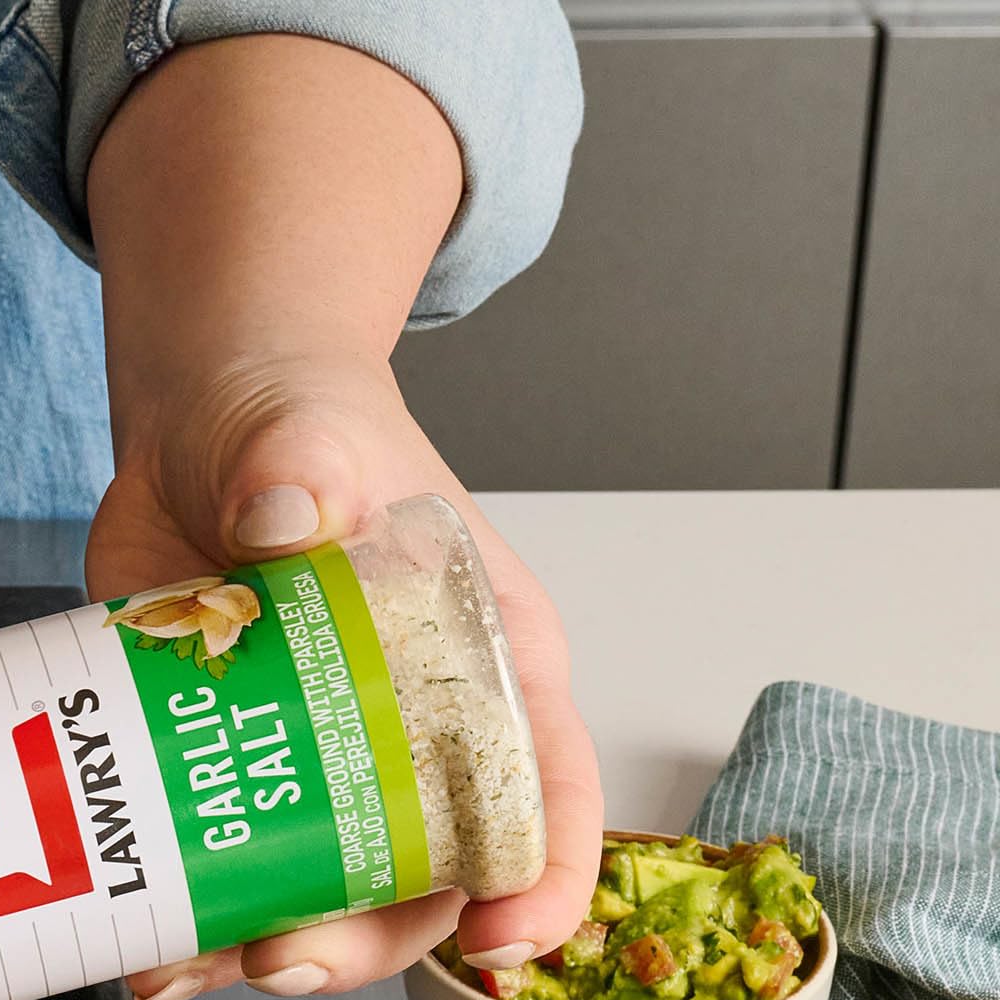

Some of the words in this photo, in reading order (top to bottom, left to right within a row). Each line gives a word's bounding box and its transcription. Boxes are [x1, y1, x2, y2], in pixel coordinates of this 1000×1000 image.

[292, 570, 328, 624] GRUESA
[275, 601, 318, 671] PARSLEY
[312, 623, 352, 698] MOLIDA
[301, 672, 335, 728] WITH
[168, 686, 251, 851] GARLIC
[230, 702, 301, 811] SALT
[318, 730, 354, 809] GROUND
[336, 698, 374, 785] PEREJIL
[58, 688, 147, 898] LAWRY'S
[362, 785, 381, 813] CON
[335, 810, 367, 873] COARSE
[362, 816, 387, 847] AJO
[373, 849, 390, 865] DE
[371, 864, 392, 889] SAL
